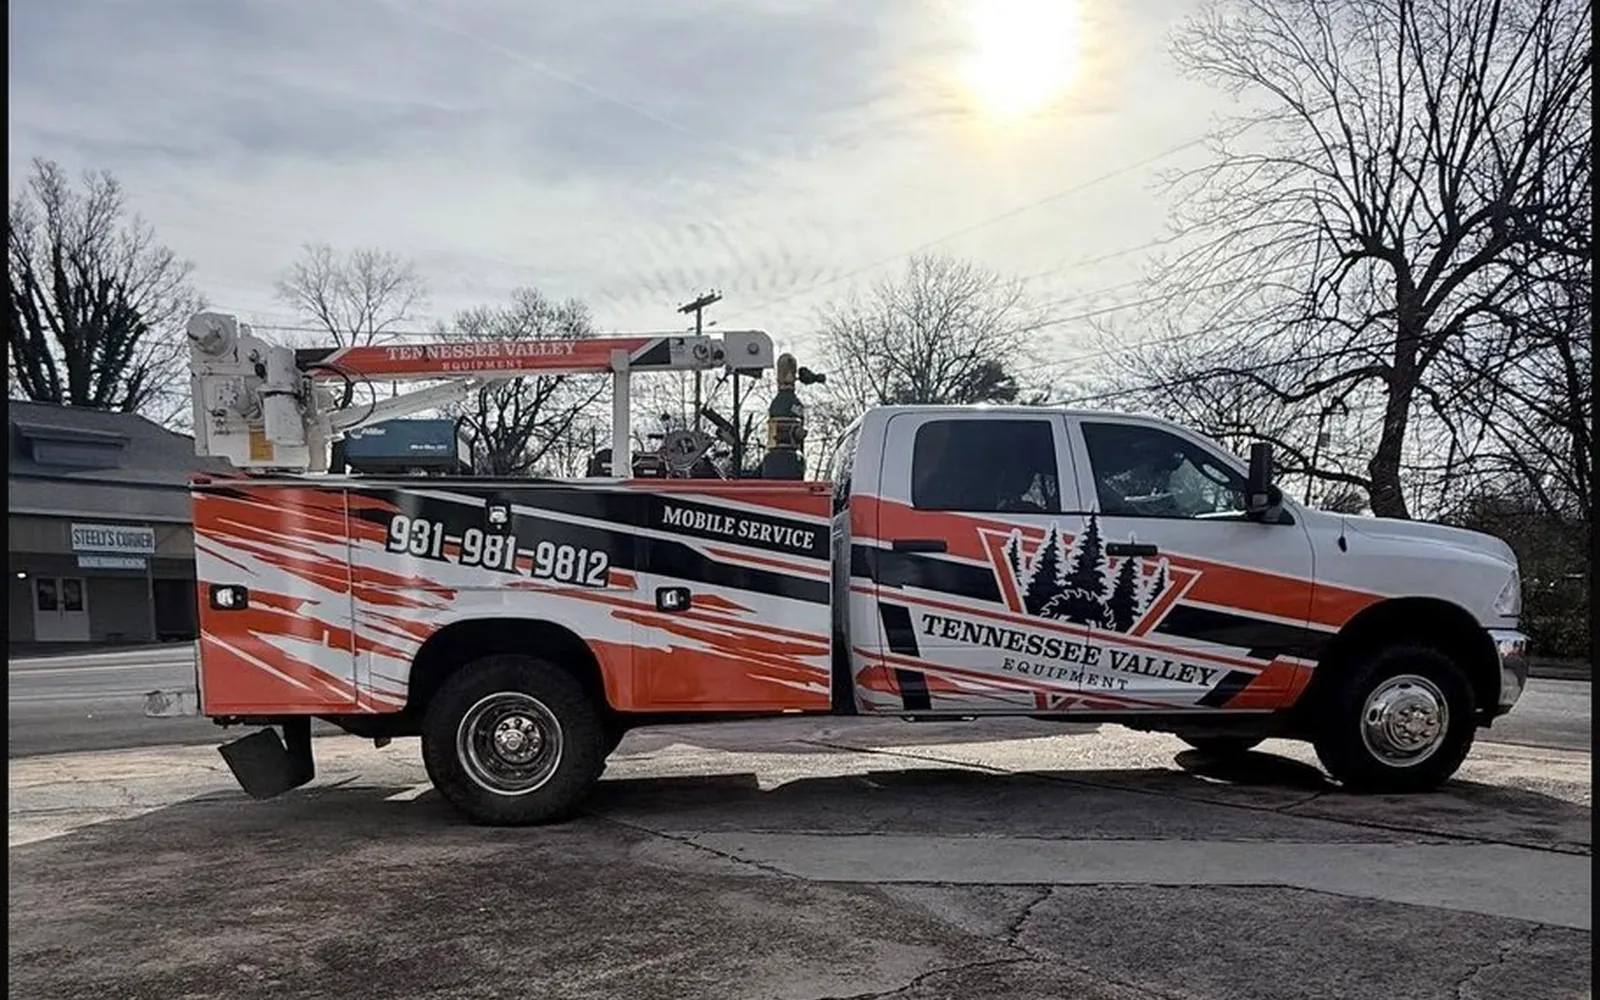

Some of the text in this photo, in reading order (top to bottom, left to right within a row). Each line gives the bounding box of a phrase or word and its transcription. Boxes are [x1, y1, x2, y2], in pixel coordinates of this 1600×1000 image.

[386, 342, 576, 361] TENNESSEE VALLEY
[442, 359, 524, 370] EQUIPMENT
[662, 505, 815, 549] MOBILE SERVICE
[388, 514, 609, 586] 931-981-9812
[921, 613, 1219, 687] TENNESSEE VALLEY
[1001, 657, 1129, 691] EQUIPMENT
